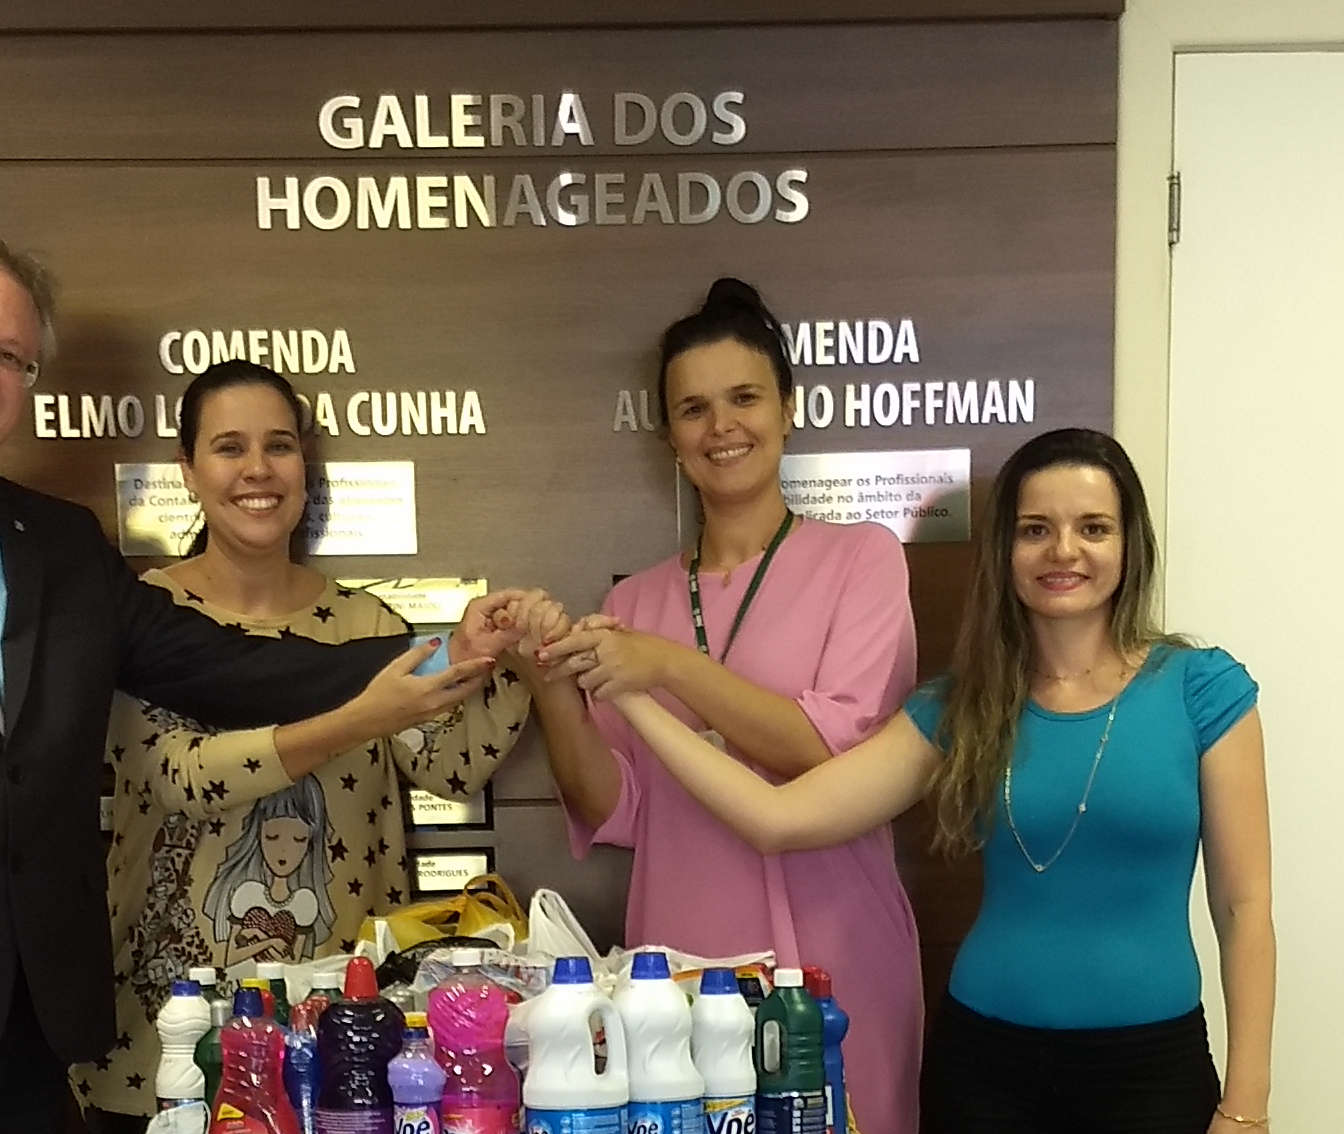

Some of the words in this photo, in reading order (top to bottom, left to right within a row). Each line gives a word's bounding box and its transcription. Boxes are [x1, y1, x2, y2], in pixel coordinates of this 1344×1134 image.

[317, 93, 595, 149] GALERIA
[613, 91, 747, 146] DOS
[256, 170, 810, 230] HOMENAGEADOS
[159, 329, 356, 374] COMENDA
[782, 319, 920, 366] MENDA
[34, 394, 145, 438] ELMO
[347, 390, 486, 437] CUNHA
[845, 380, 1035, 427] HOFFMAN
[781, 477, 853, 491] omenagear
[856, 476, 871, 487] os
[875, 472, 954, 487] Profissionais
[783, 492, 834, 506] bilidade
[837, 494, 854, 504] no
[857, 490, 902, 503] âmbito
[905, 490, 922, 502] da
[846, 510, 862, 520] ao
[865, 508, 899, 520] Setor
[418, 803, 453, 811] PONTES
[418, 869, 469, 878] RODRIGUES
